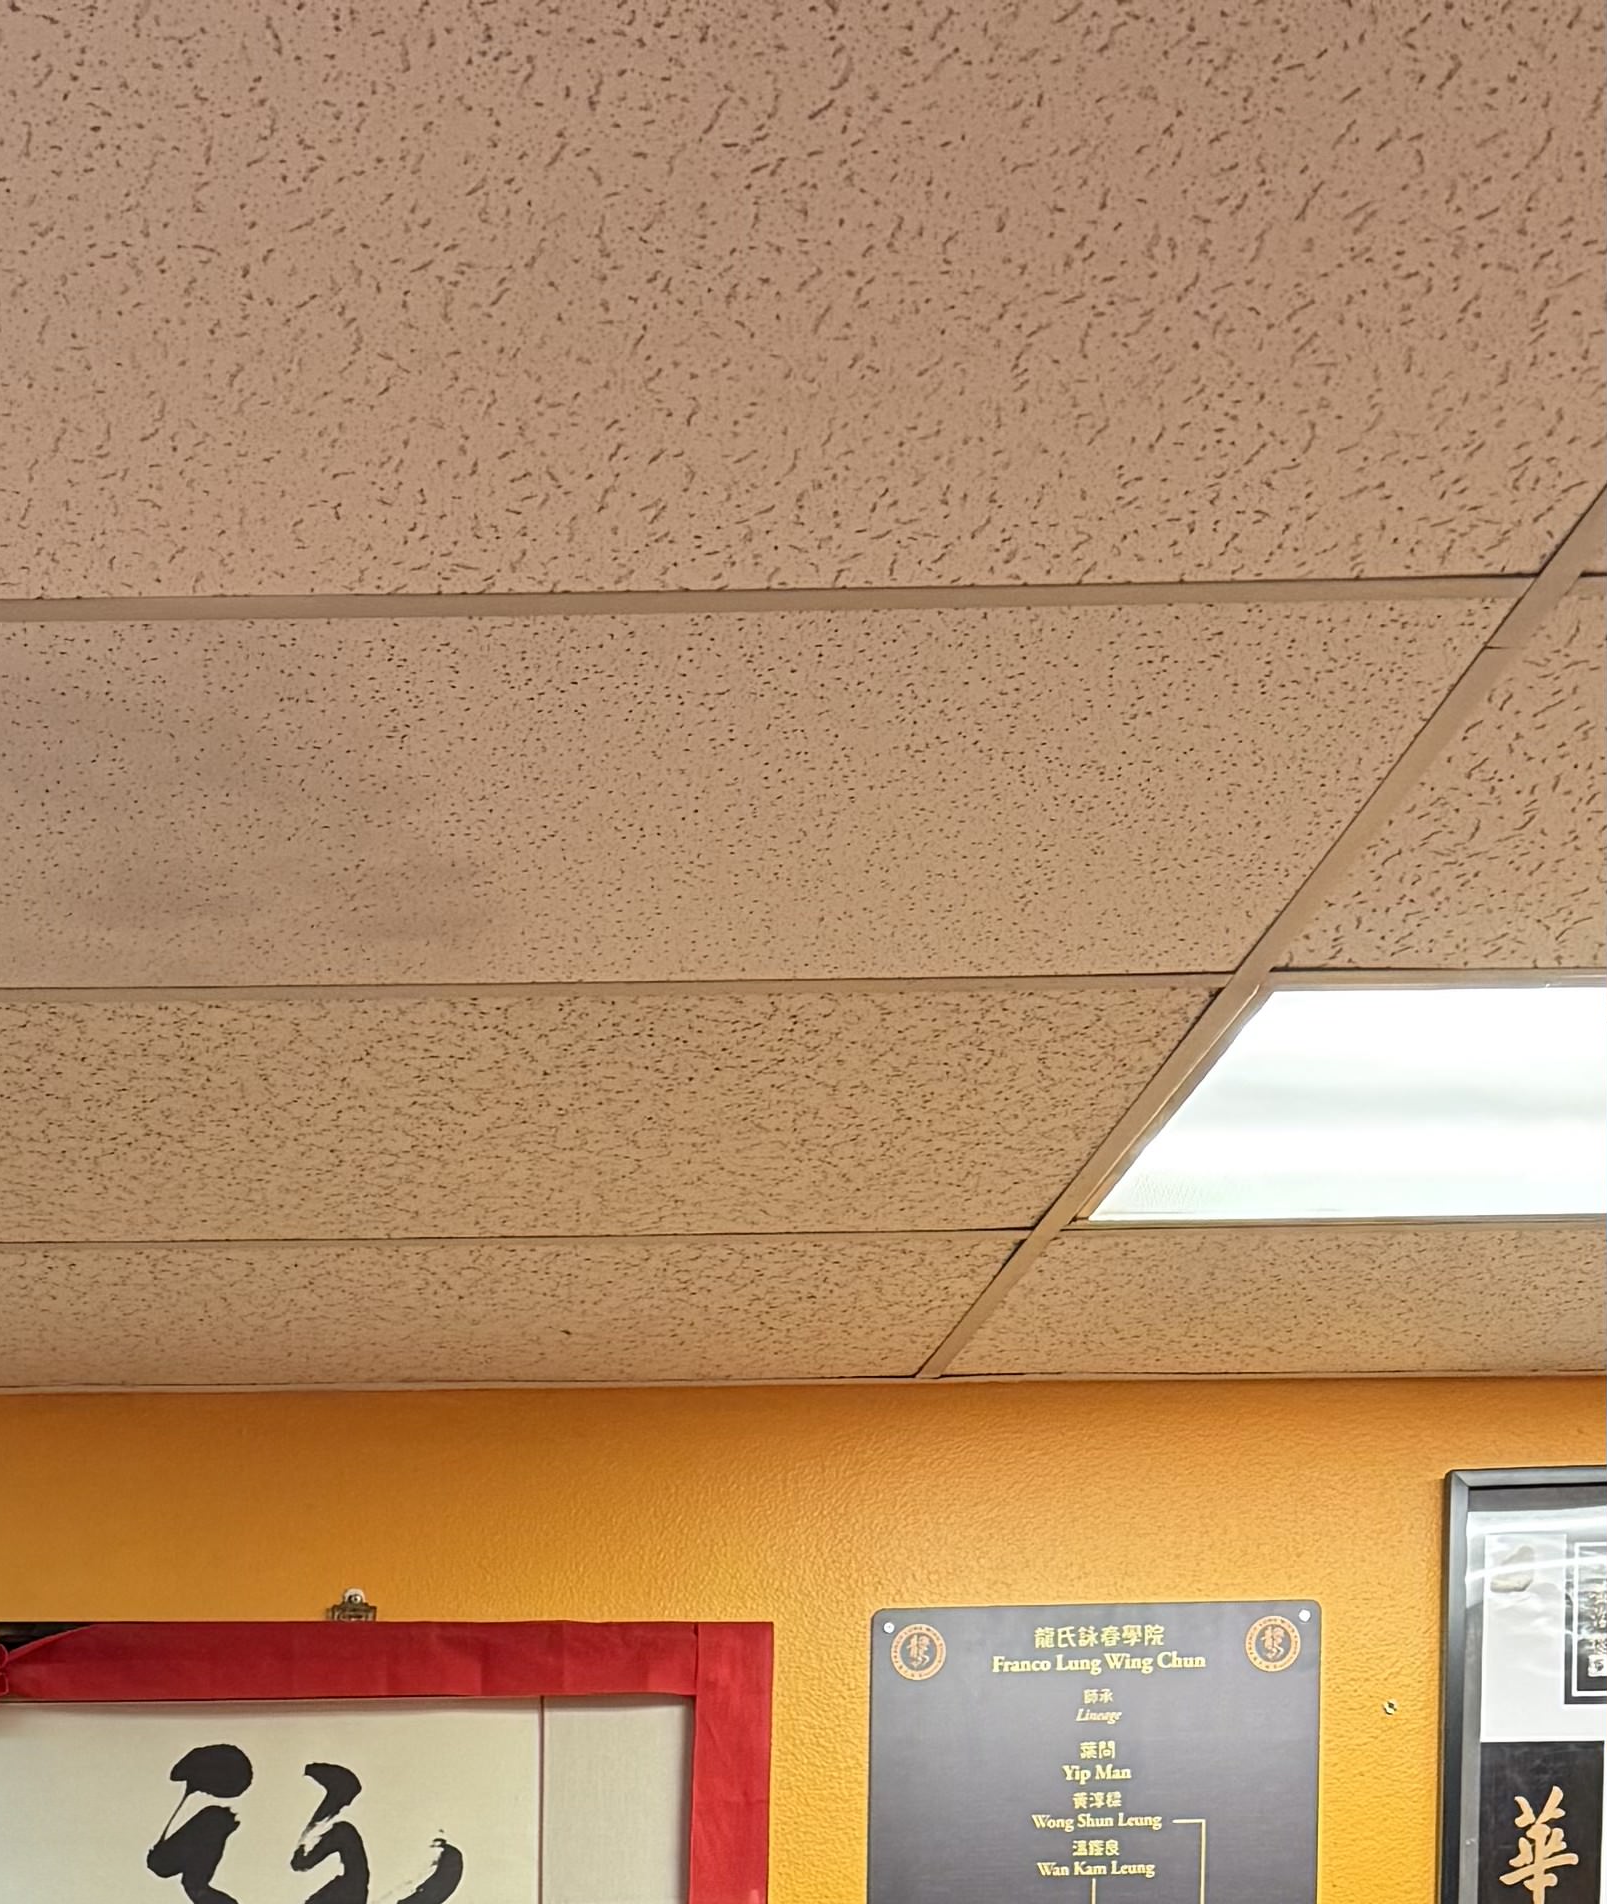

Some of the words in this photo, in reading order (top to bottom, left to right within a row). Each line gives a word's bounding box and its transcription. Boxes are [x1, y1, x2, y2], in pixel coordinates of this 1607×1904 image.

[992, 1655, 1051, 1673] Franco
[1055, 1653, 1102, 1675] Lung
[1104, 1652, 1154, 1674] Wing
[1157, 1651, 1207, 1669] Chun
[1076, 1709, 1122, 1725] Lineage
[1062, 1765, 1091, 1785] Yip
[1095, 1764, 1132, 1780] Man
[1031, 1814, 1074, 1832] Wong
[1077, 1813, 1114, 1828] Shun
[1118, 1813, 1162, 1830] Leung
[1037, 1862, 1069, 1877] Wan
[1074, 1861, 1107, 1876] Kam
[1110, 1861, 1156, 1878] Leung
